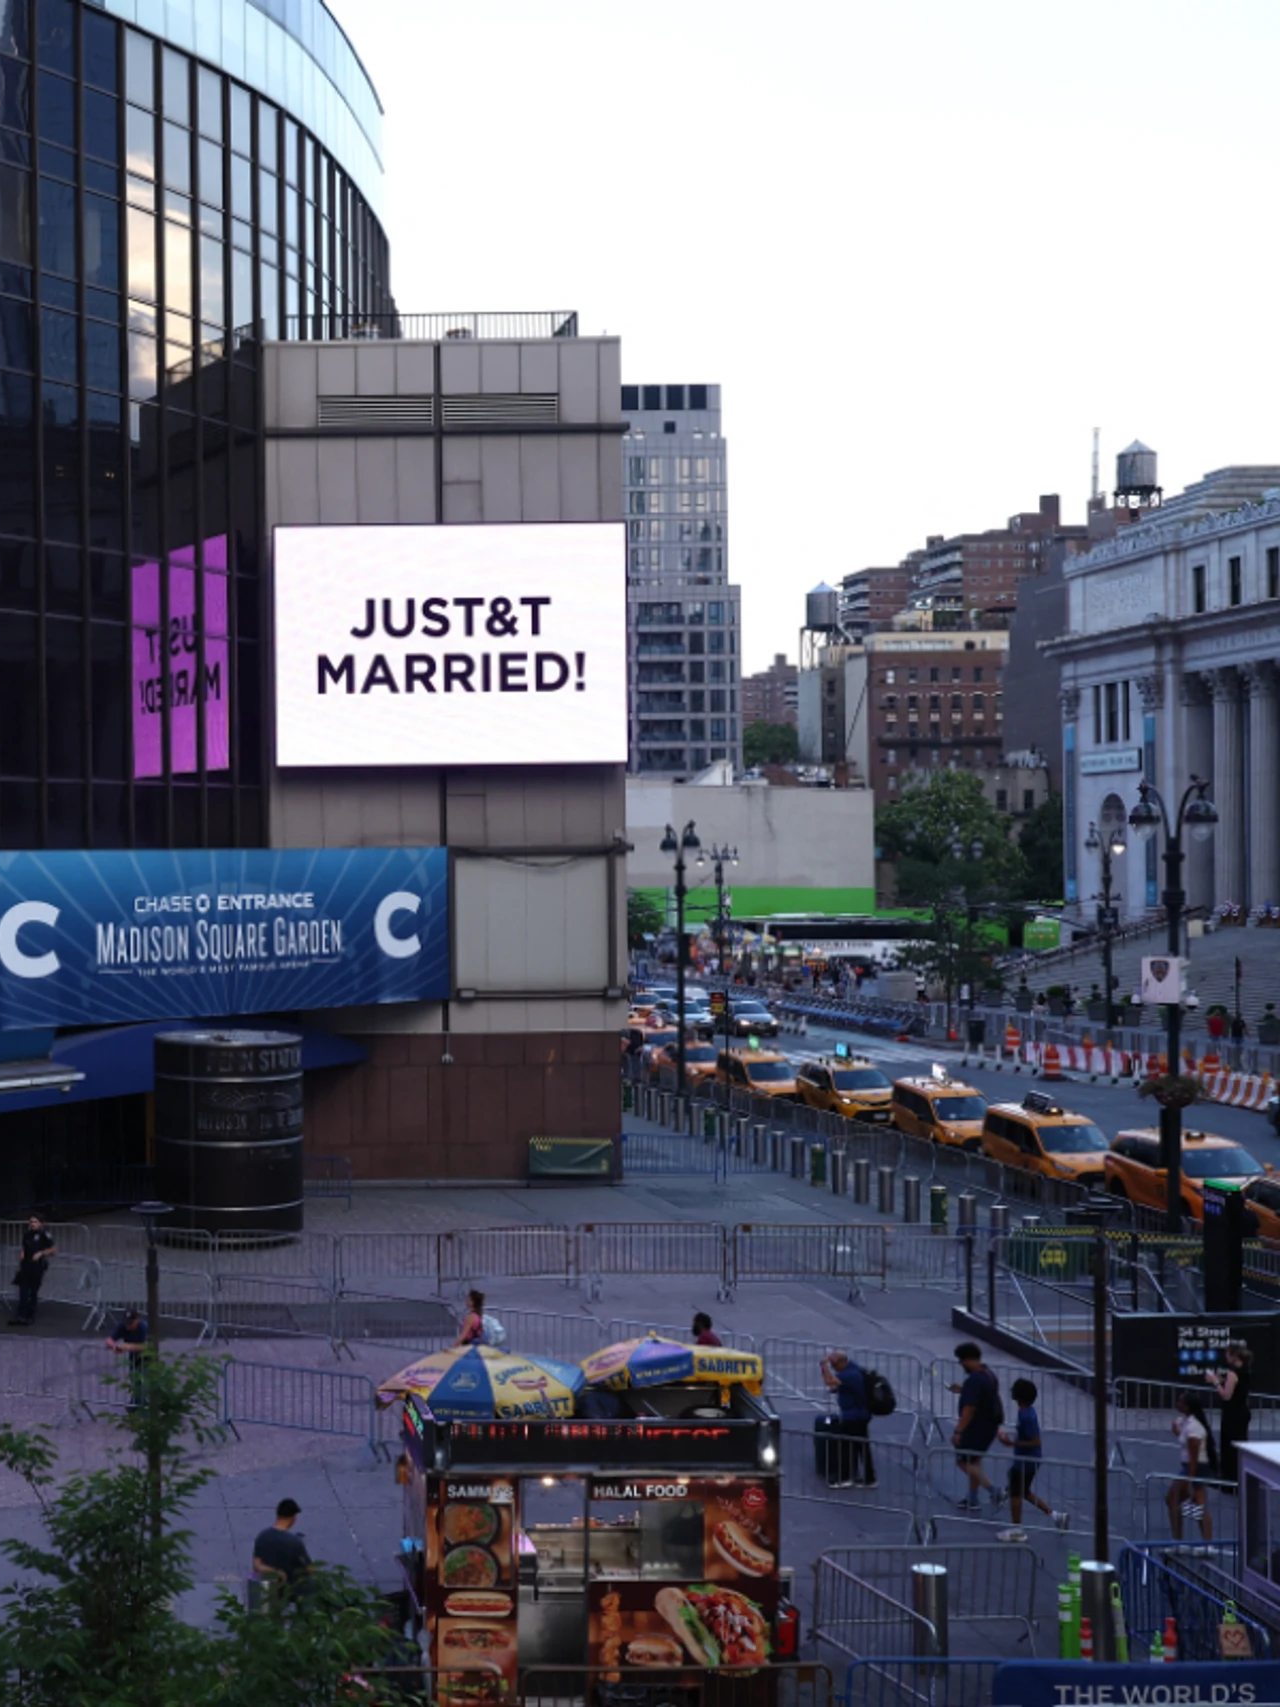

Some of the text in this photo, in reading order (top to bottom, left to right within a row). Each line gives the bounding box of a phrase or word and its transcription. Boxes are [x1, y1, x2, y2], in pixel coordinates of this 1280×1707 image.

[350, 596, 552, 638] JUST&T
[317, 652, 586, 694] MARRIED!
[134, 892, 315, 912] CHASE ENTRANCE
[373, 891, 421, 959] C
[96, 916, 342, 965] MADISON SQUARE GARDEN
[698, 1358, 758, 1375] SABRETT
[501, 1398, 570, 1418] SABRTT
[594, 1484, 688, 1498] HALAL FOOD
[1054, 1683, 1256, 1704] THE WORLD'S
